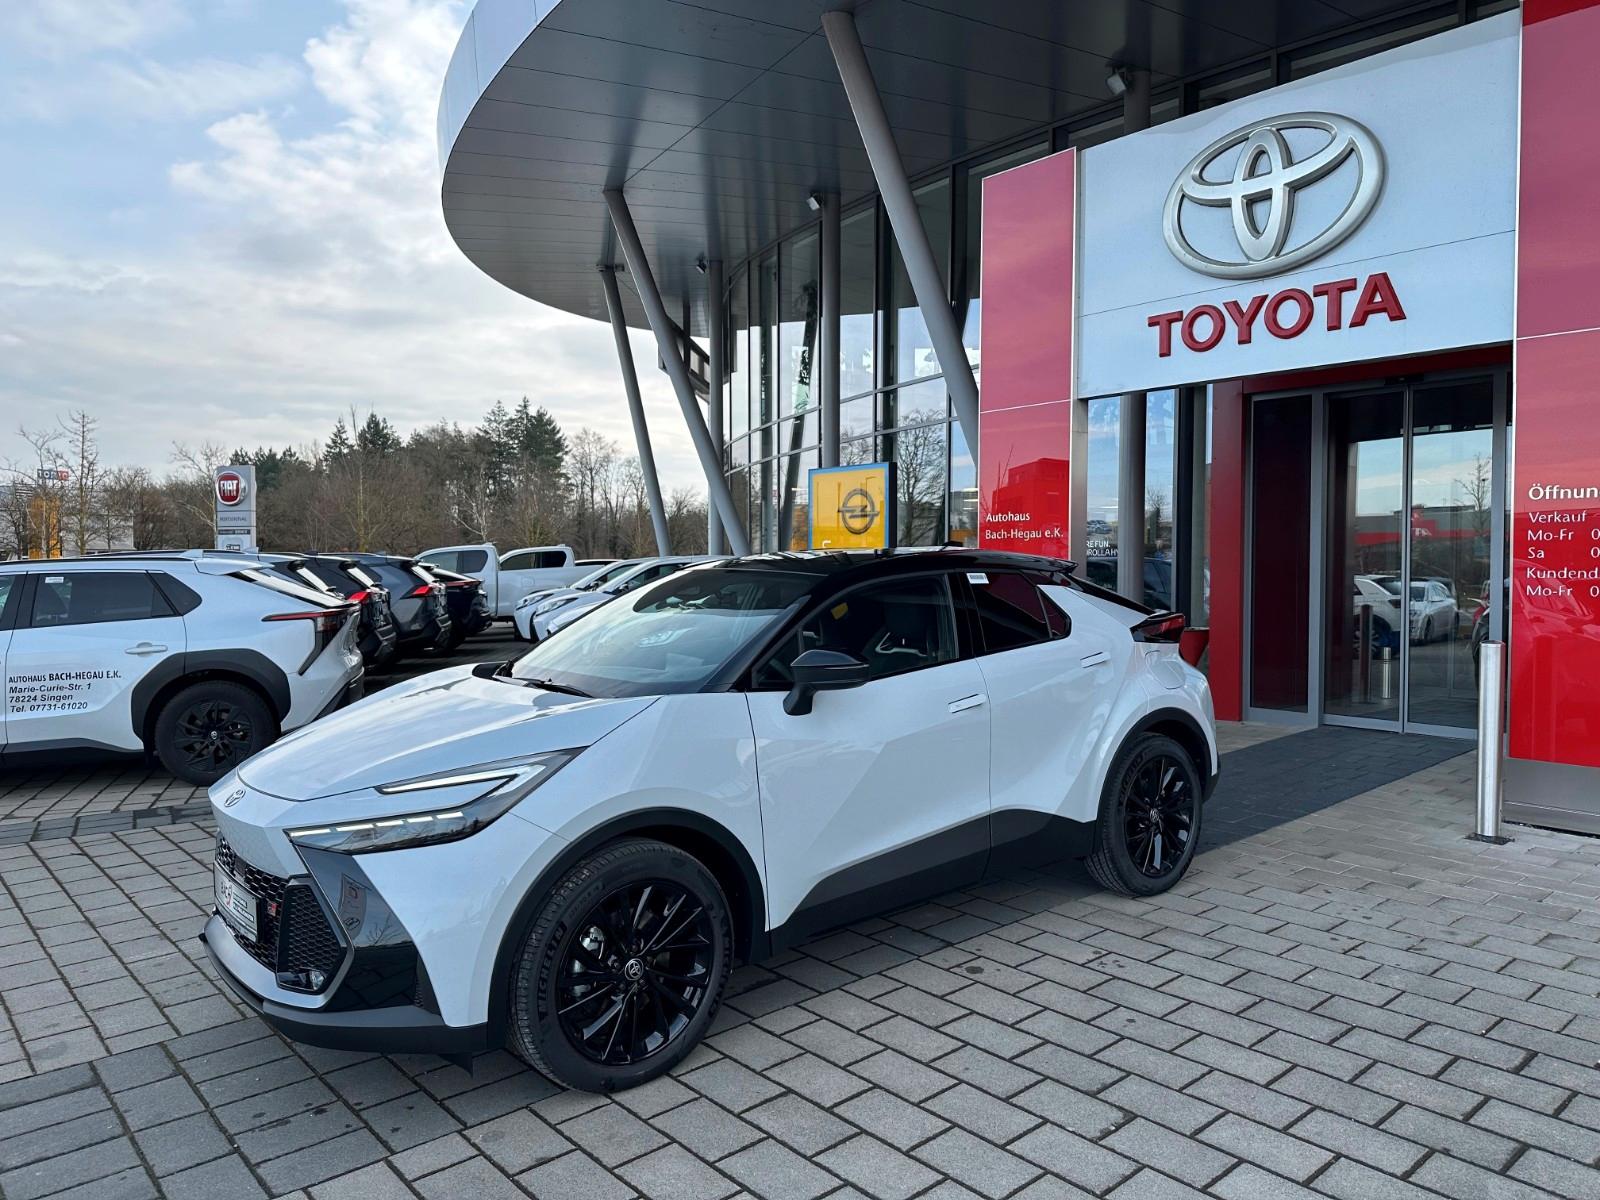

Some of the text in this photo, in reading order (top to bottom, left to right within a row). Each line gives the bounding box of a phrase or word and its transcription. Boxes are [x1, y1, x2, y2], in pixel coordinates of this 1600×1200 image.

[1147, 272, 1407, 358] TOYOTA
[220, 480, 238, 497] FIAT
[1529, 484, 1600, 500] Öffnun
[986, 511, 1031, 522] Autohaus
[1529, 510, 1587, 523] Verkauf
[985, 527, 1064, 541] Bach-Hegau e.K.
[1527, 529, 1574, 541] Mo-Fr
[1527, 547, 1545, 559] Sa
[1526, 585, 1573, 597] Mo-Fr
[9, 670, 121, 683] AUTOHAUS BACH-HEGAU E.K.
[9, 684, 84, 694] Marie-Curie-Str.
[40, 693, 73, 703] Singen
[10, 702, 88, 713] Tel. 07731-61020
